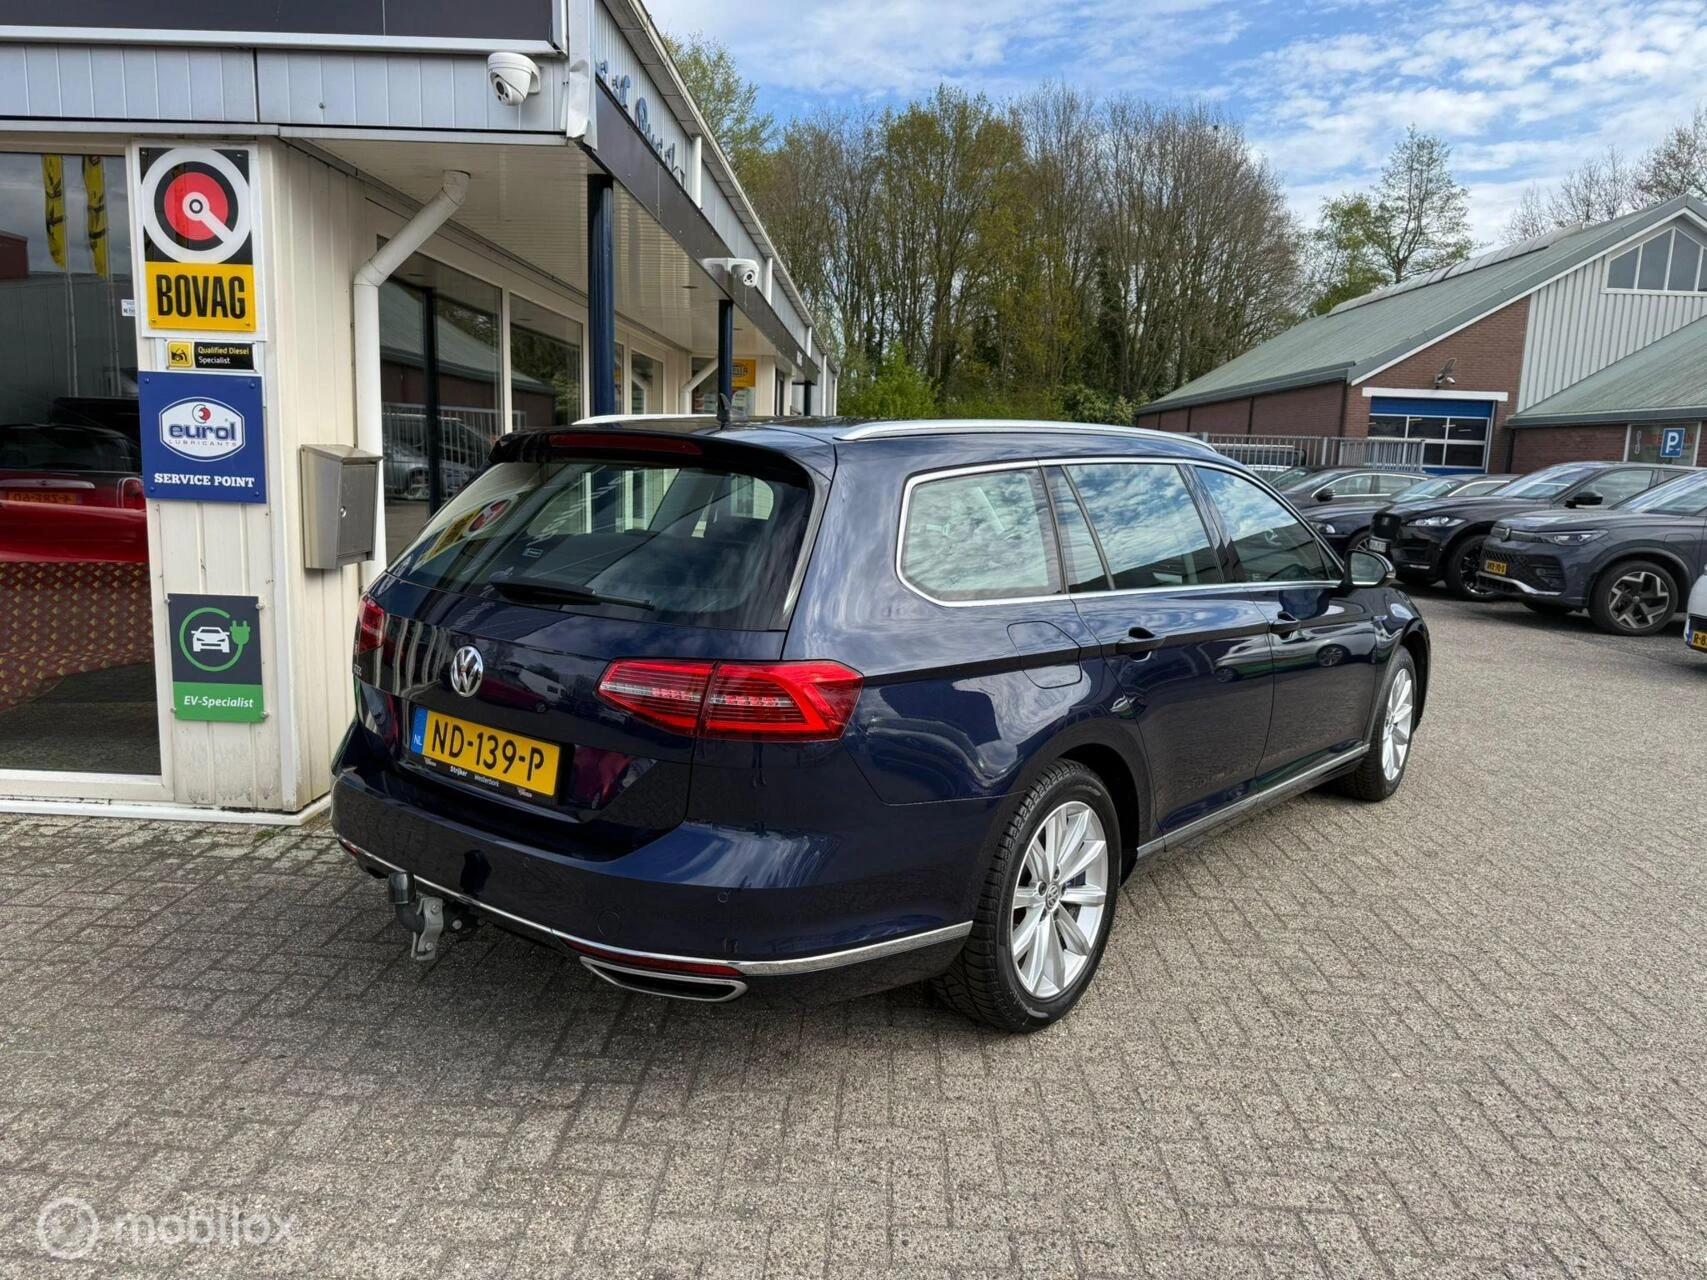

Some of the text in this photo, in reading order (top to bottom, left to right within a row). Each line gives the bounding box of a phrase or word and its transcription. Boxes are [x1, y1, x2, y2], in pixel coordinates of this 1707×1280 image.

[156, 274, 246, 319] BOVAG
[198, 346, 249, 355] Qualified Diesel
[198, 356, 230, 364] Specialist
[169, 422, 236, 440] eurol
[1665, 432, 1679, 453] P
[154, 473, 255, 487] SERVICE POINT
[184, 696, 254, 708] EV-Specialist
[413, 734, 423, 746] NL
[432, 719, 545, 782] ND-139-P
